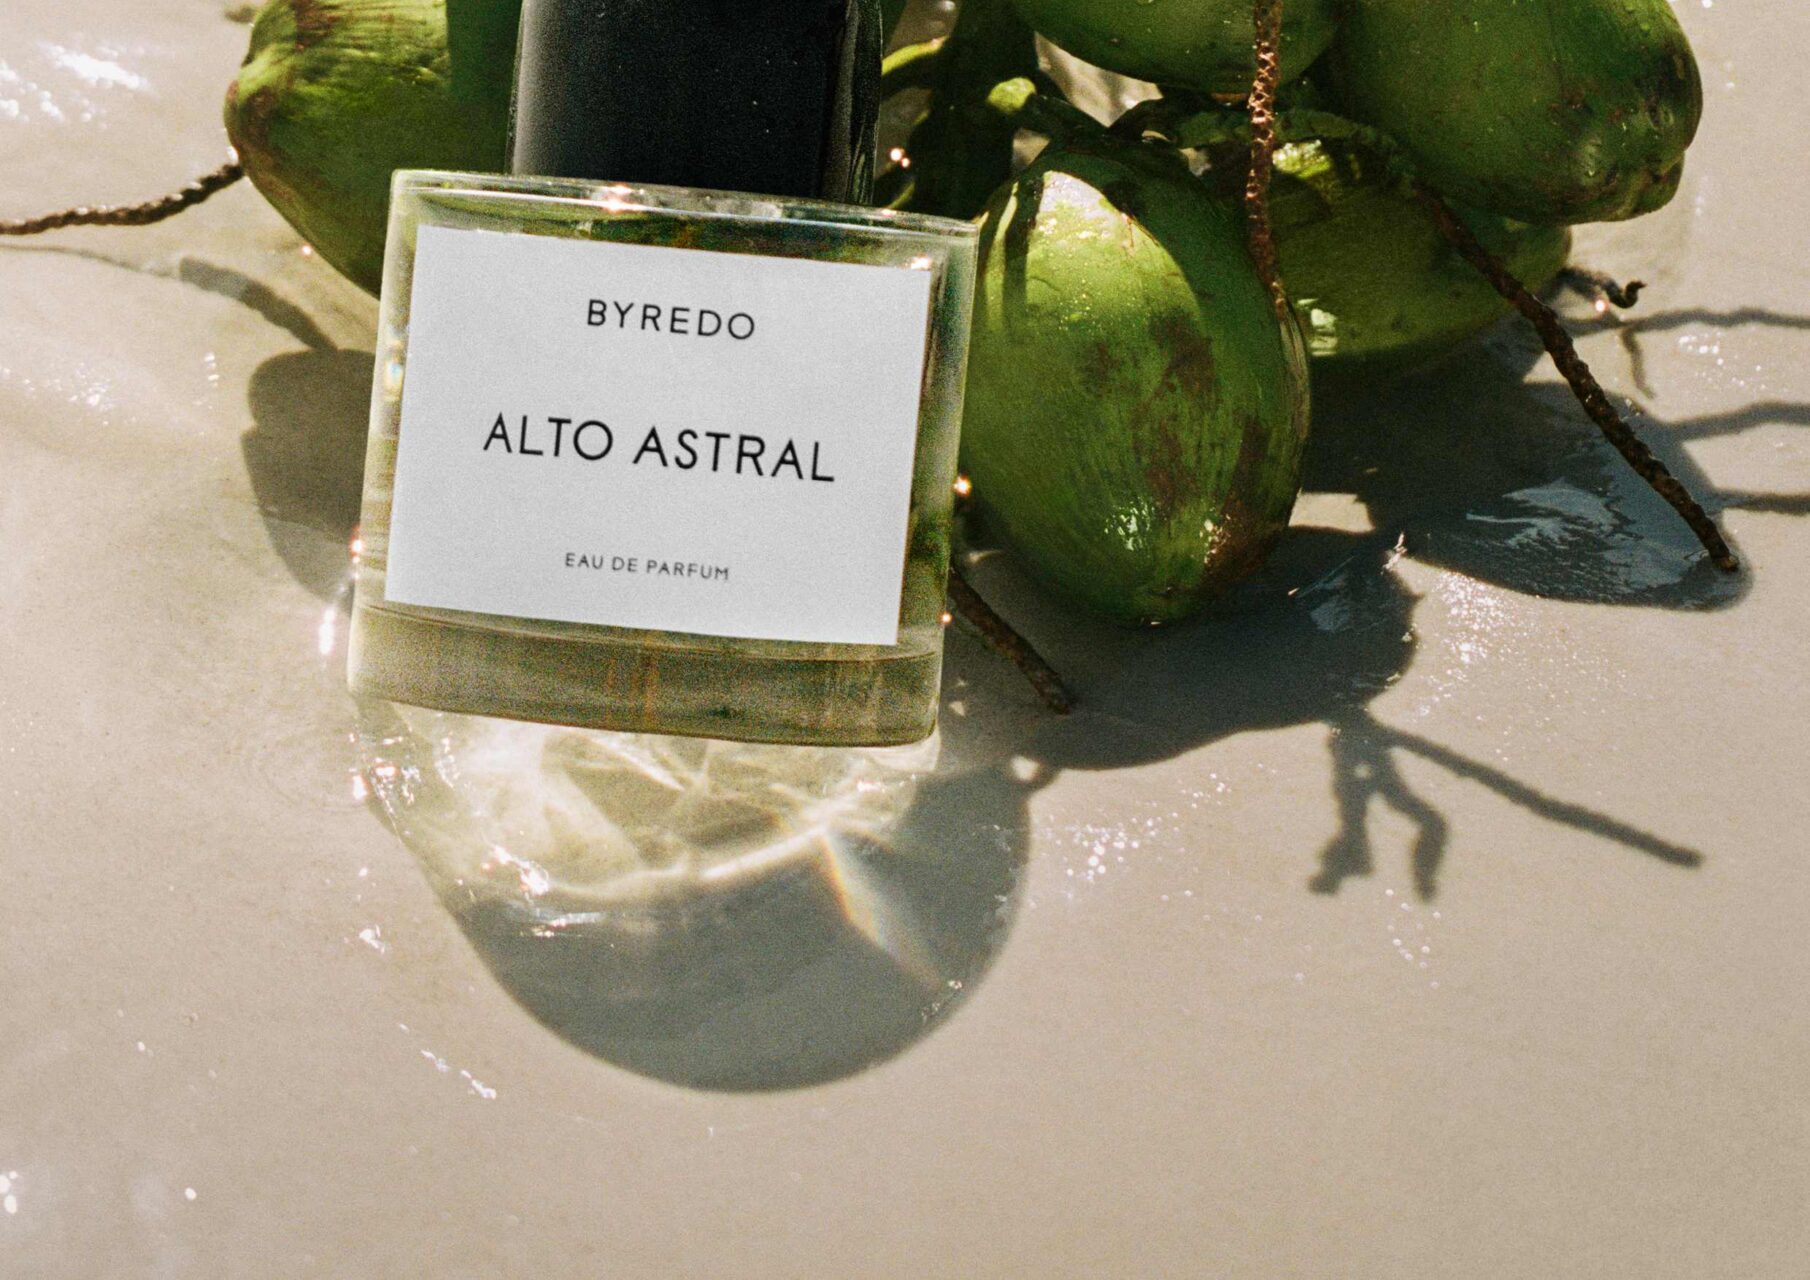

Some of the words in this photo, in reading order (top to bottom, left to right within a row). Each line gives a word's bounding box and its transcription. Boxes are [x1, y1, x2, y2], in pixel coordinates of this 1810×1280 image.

[586, 298, 756, 340] BYREDO
[482, 412, 614, 462] ALTO
[632, 426, 836, 483] ASTRAL
[564, 552, 605, 571] EAU
[611, 556, 639, 574] DE
[645, 559, 730, 581] PARFUM
